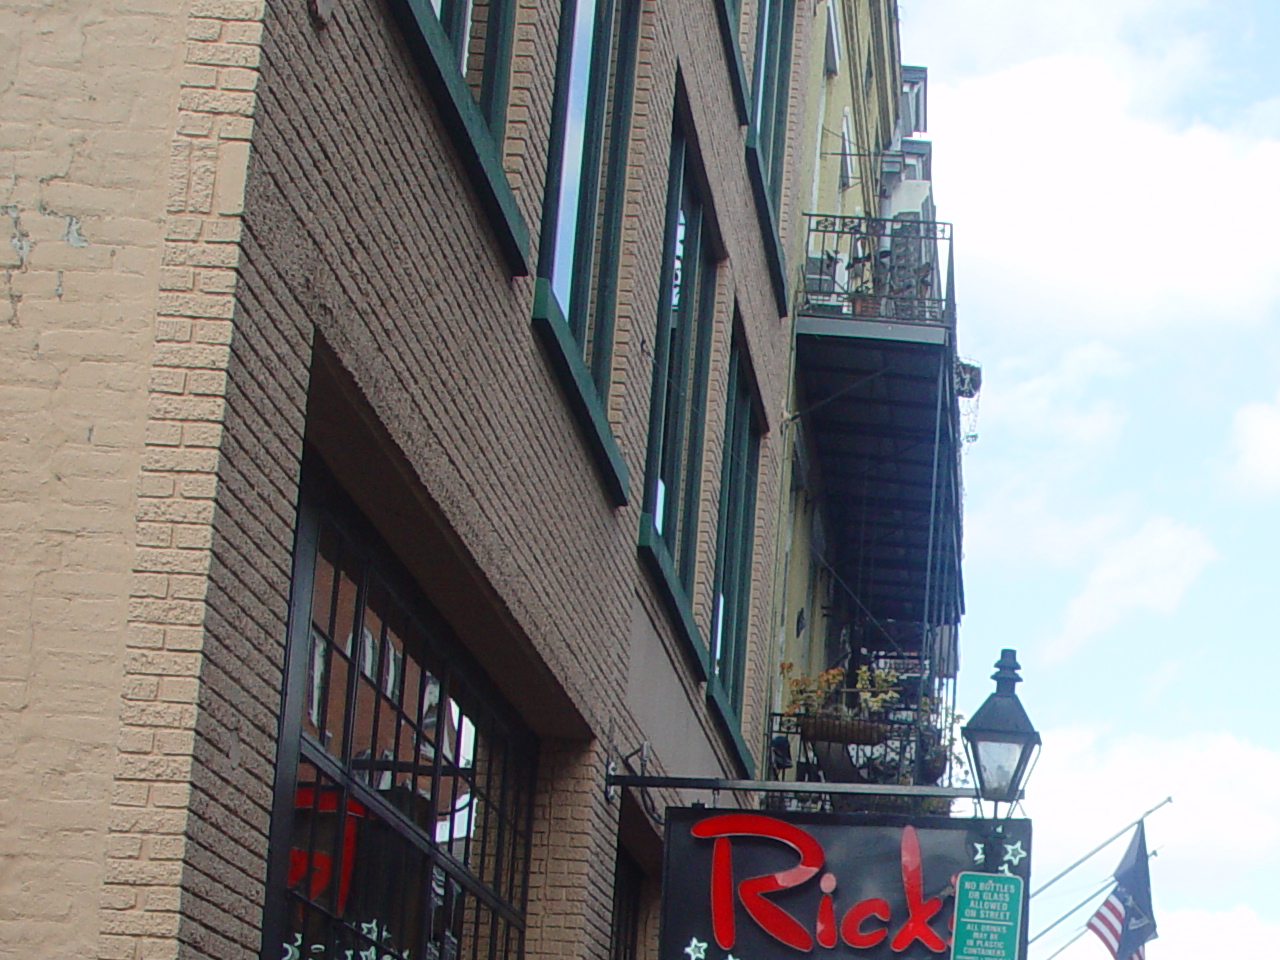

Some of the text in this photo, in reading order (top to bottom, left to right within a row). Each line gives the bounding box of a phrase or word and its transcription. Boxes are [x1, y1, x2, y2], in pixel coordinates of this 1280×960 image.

[964, 881, 1016, 893] NO BOTTLES
[968, 891, 1010, 902] OR GLASS
[969, 899, 1008, 910] ALLOWED
[964, 908, 1011, 920] ON STREET
[966, 923, 1007, 933] ALL DRINKS
[972, 931, 987, 939] MAY
[976, 940, 1005, 948] PLASTIC
[963, 947, 1005, 956] CONTAINERS
